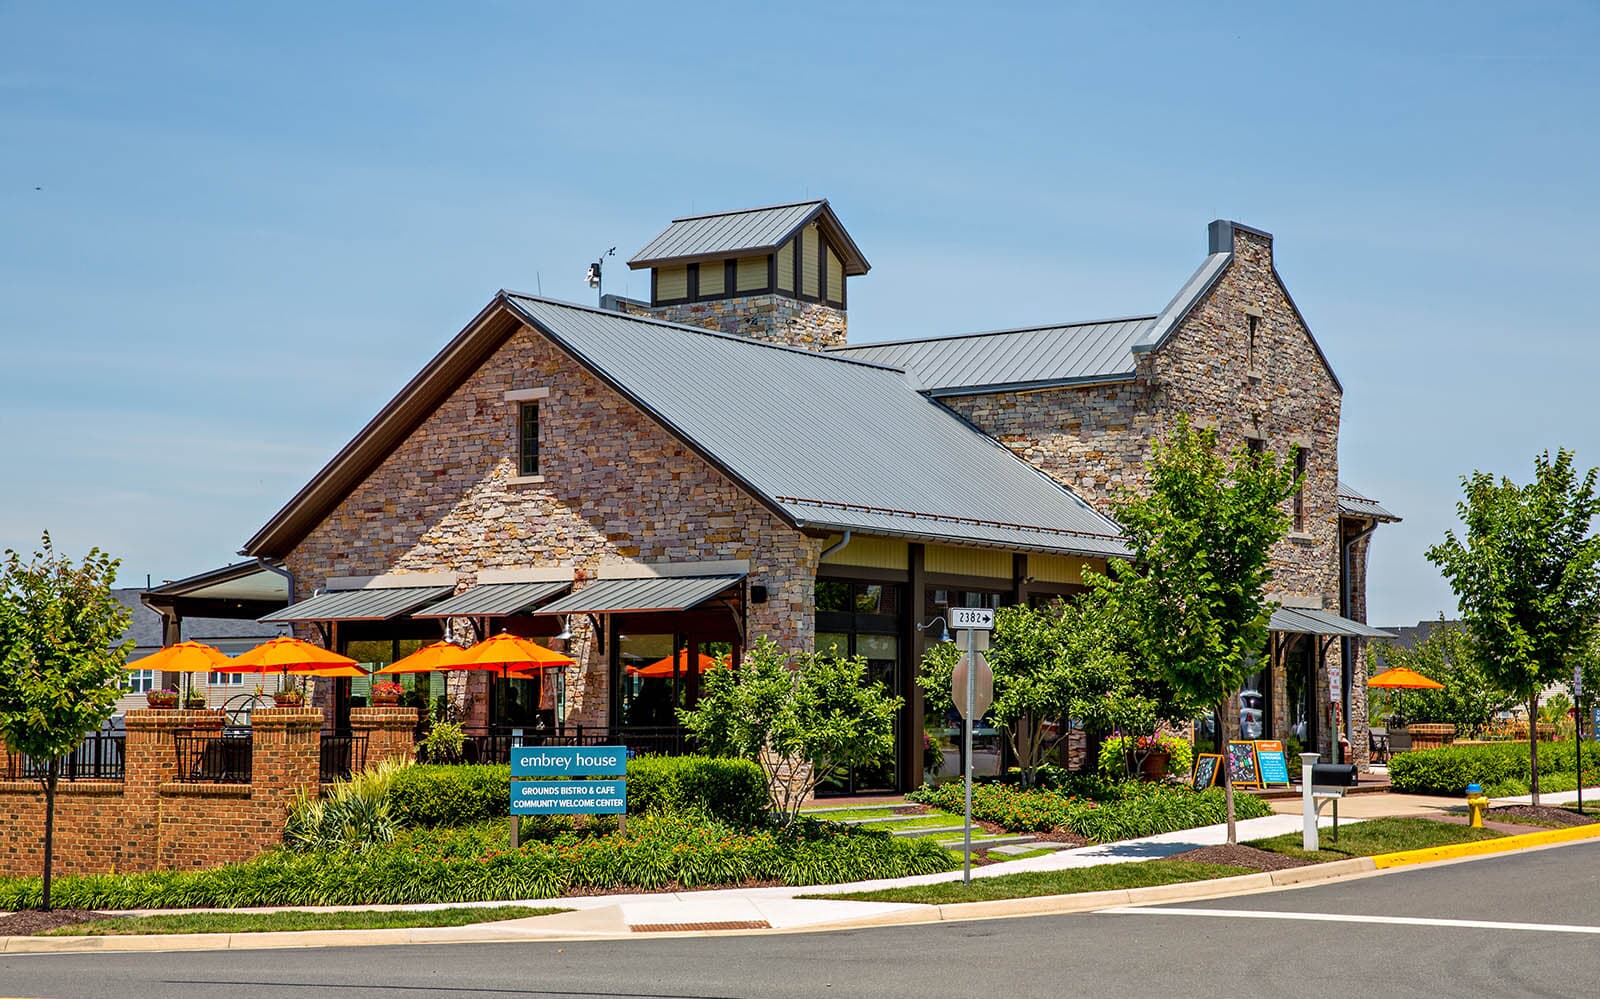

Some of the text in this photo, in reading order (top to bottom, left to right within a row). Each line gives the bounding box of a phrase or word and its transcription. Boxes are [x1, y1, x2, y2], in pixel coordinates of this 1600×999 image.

[959, 612, 981, 623] 2382
[520, 753, 617, 770] embrey house
[521, 787, 559, 795] GROUNDS
[560, 786, 587, 795] BISTRO
[595, 786, 615, 794] CAFE
[513, 799, 624, 808] COMMUNITY WELCOME CENTER
